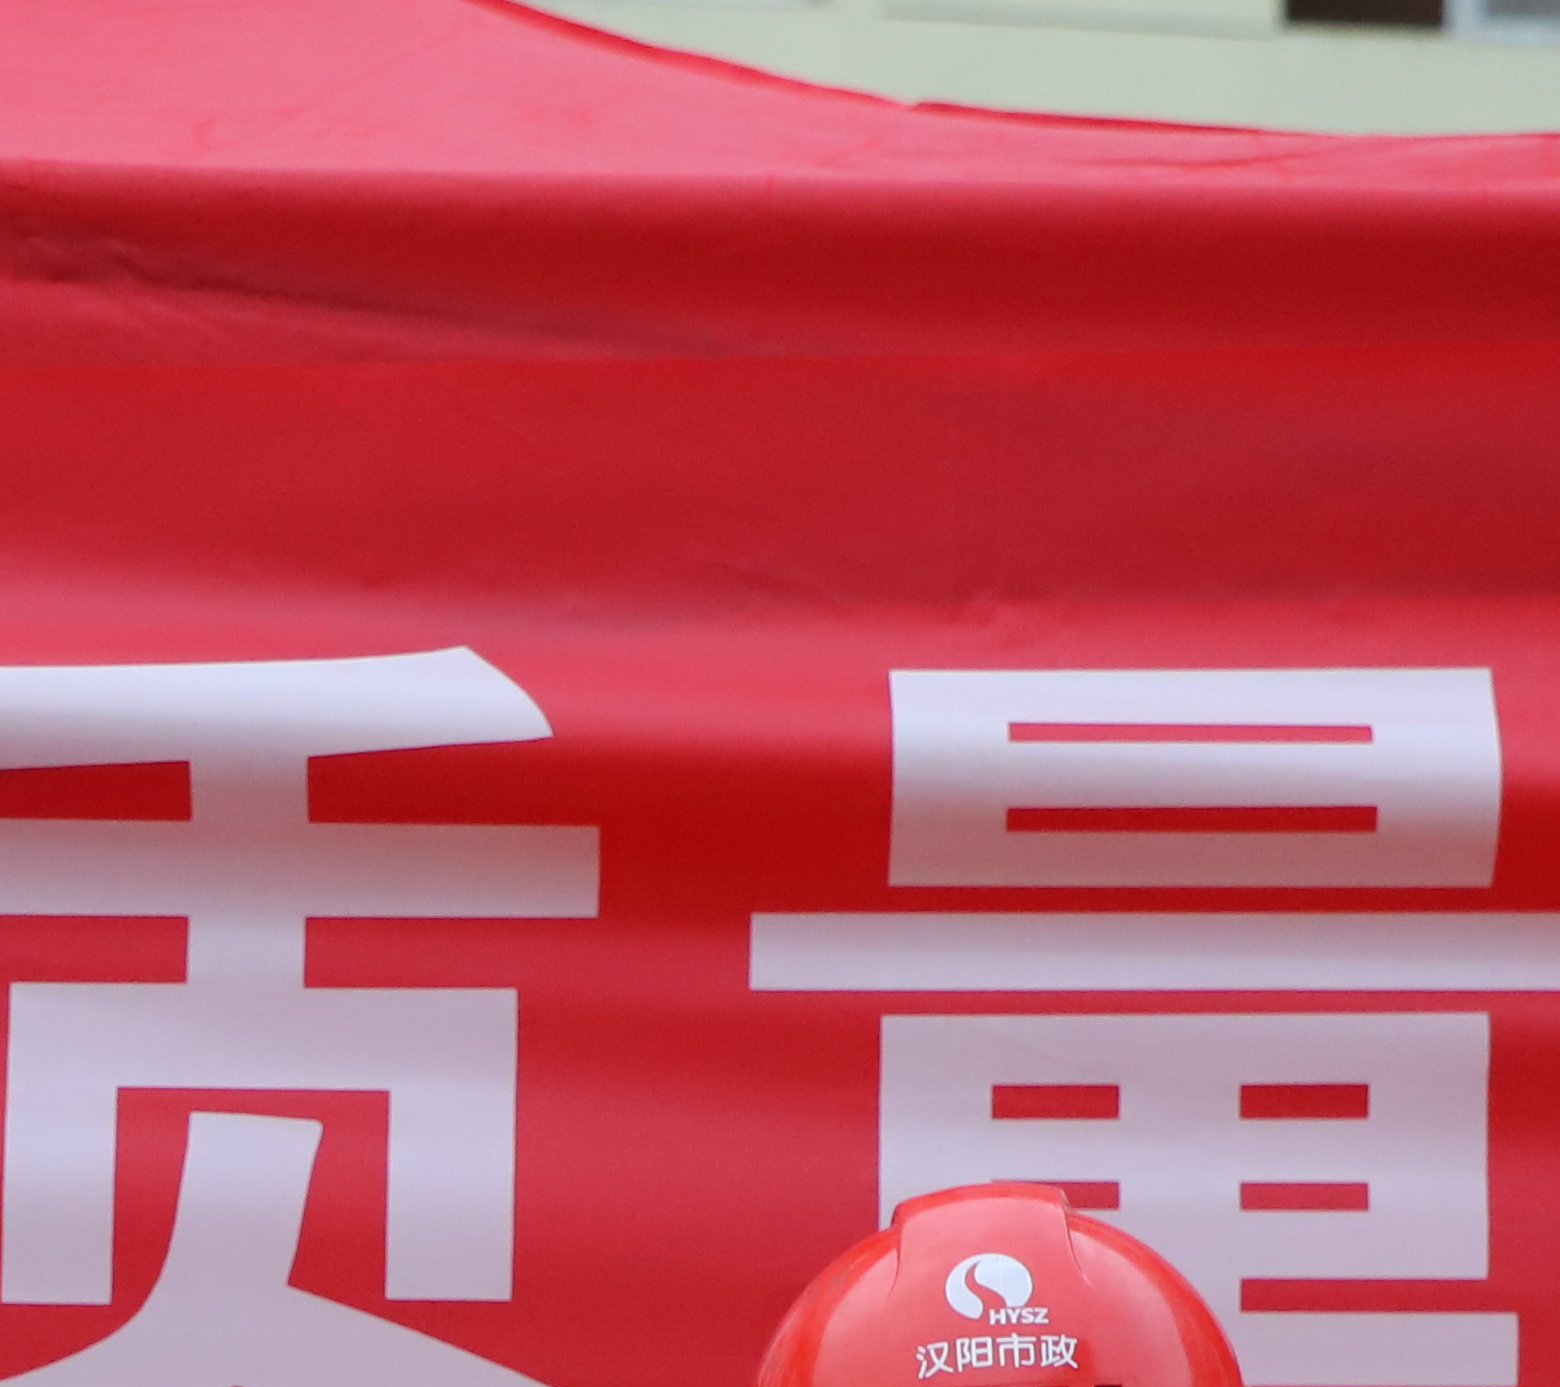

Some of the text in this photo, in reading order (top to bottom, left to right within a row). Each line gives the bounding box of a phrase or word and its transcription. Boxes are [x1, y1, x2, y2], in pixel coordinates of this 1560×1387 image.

[989, 1306, 1049, 1325] HYSZ
[916, 1332, 1078, 1379] 汉阳市政
